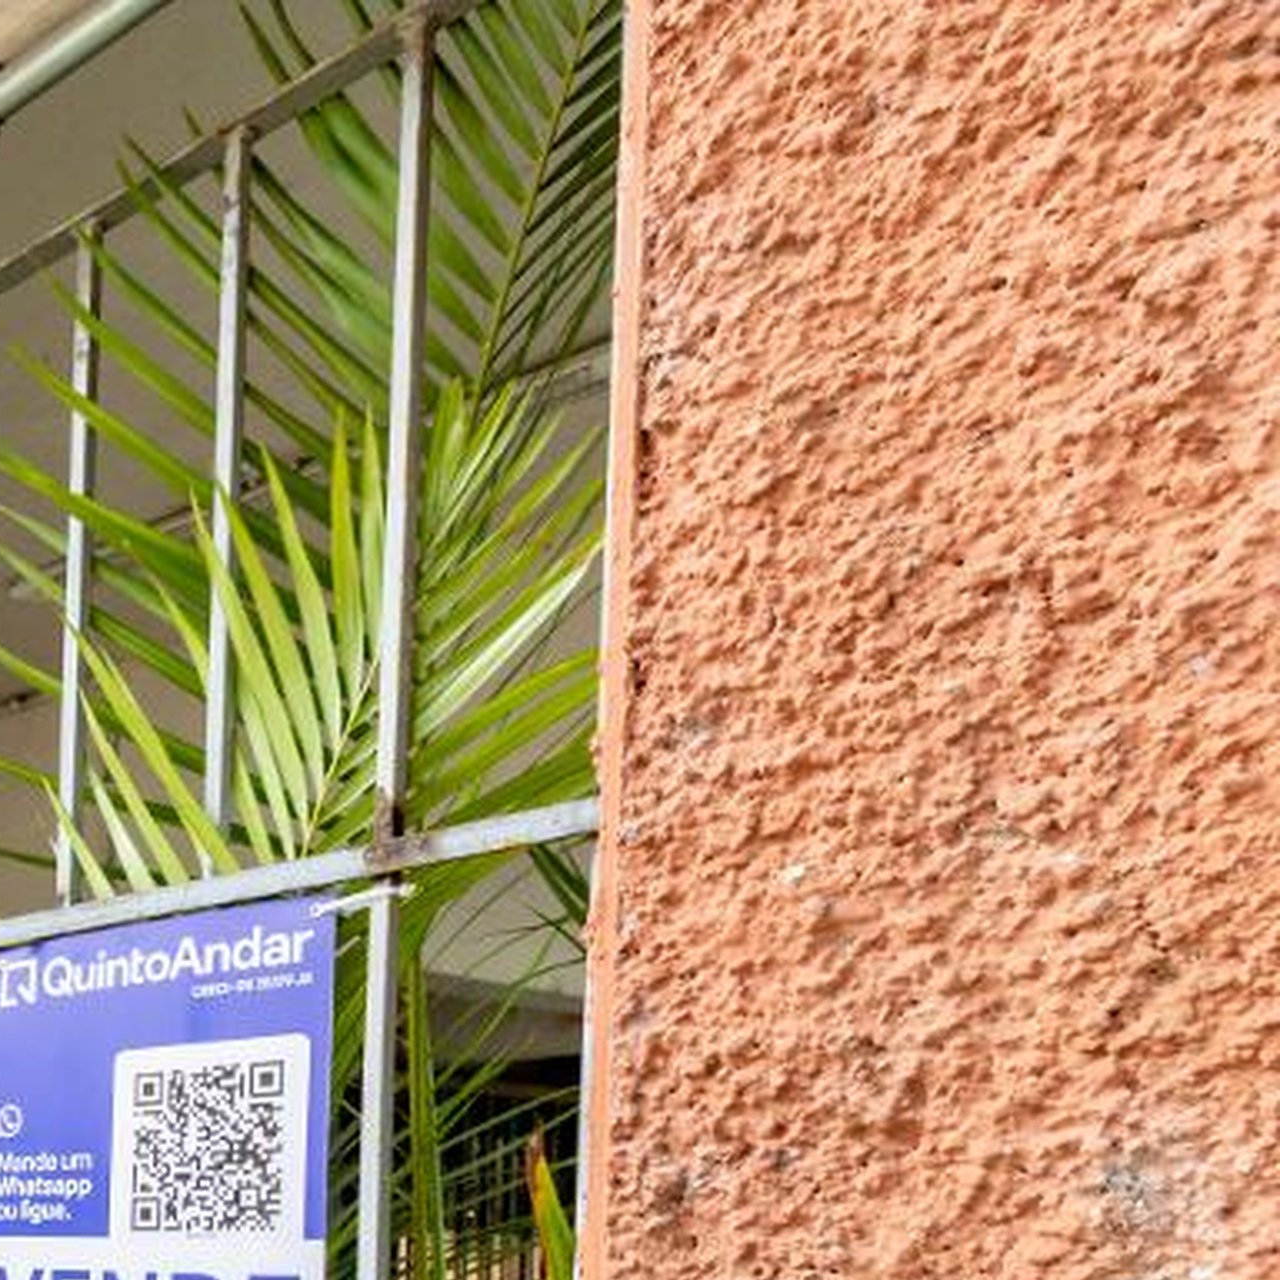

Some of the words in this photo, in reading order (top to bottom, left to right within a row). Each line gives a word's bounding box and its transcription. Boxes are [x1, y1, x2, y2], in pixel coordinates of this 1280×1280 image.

[42, 926, 314, 998] QuintoAndar
[61, 1152, 92, 1172] um
[20, 1199, 72, 1225] ligue.
